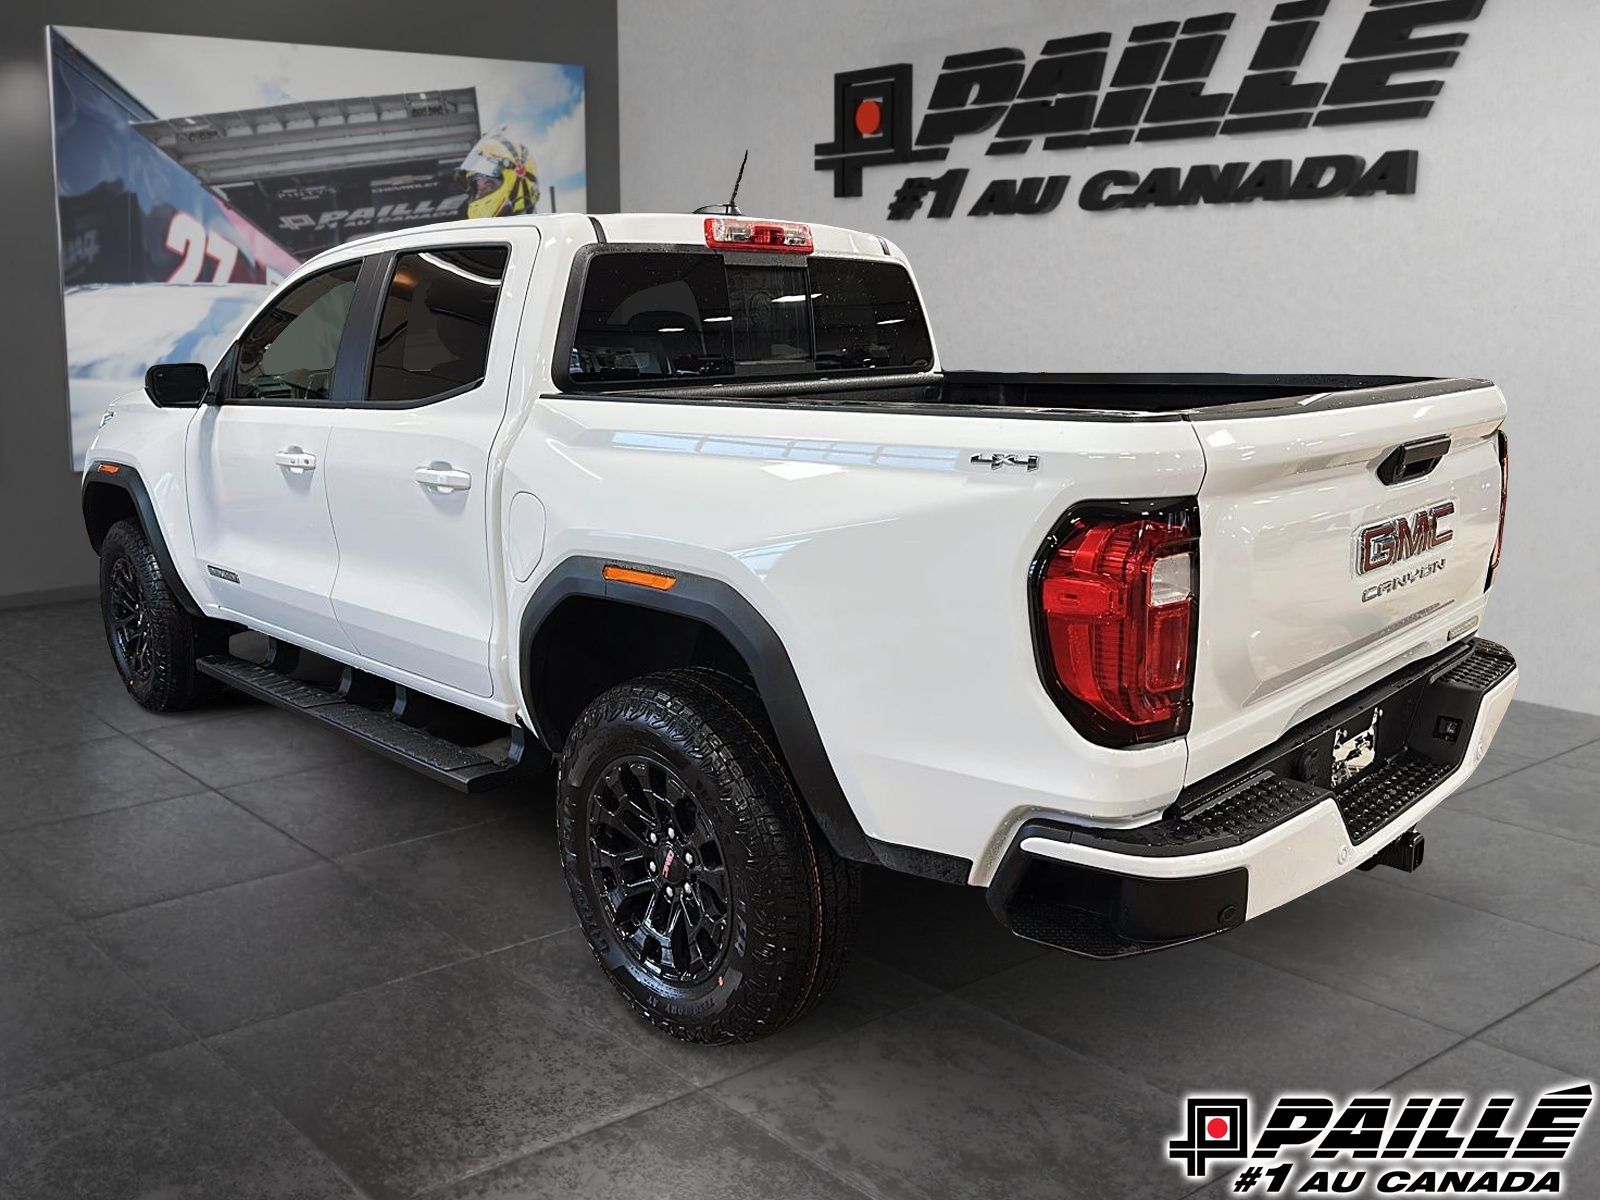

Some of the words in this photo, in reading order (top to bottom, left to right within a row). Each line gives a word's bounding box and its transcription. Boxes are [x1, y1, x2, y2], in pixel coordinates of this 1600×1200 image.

[371, 182, 438, 193] CHEVROLET
[887, 168, 970, 221] #1
[967, 175, 1071, 217] AU
[1077, 149, 1418, 212] CANADA
[166, 211, 238, 285] 27
[1357, 501, 1454, 575] GMC
[1361, 558, 1446, 603] CANYON
